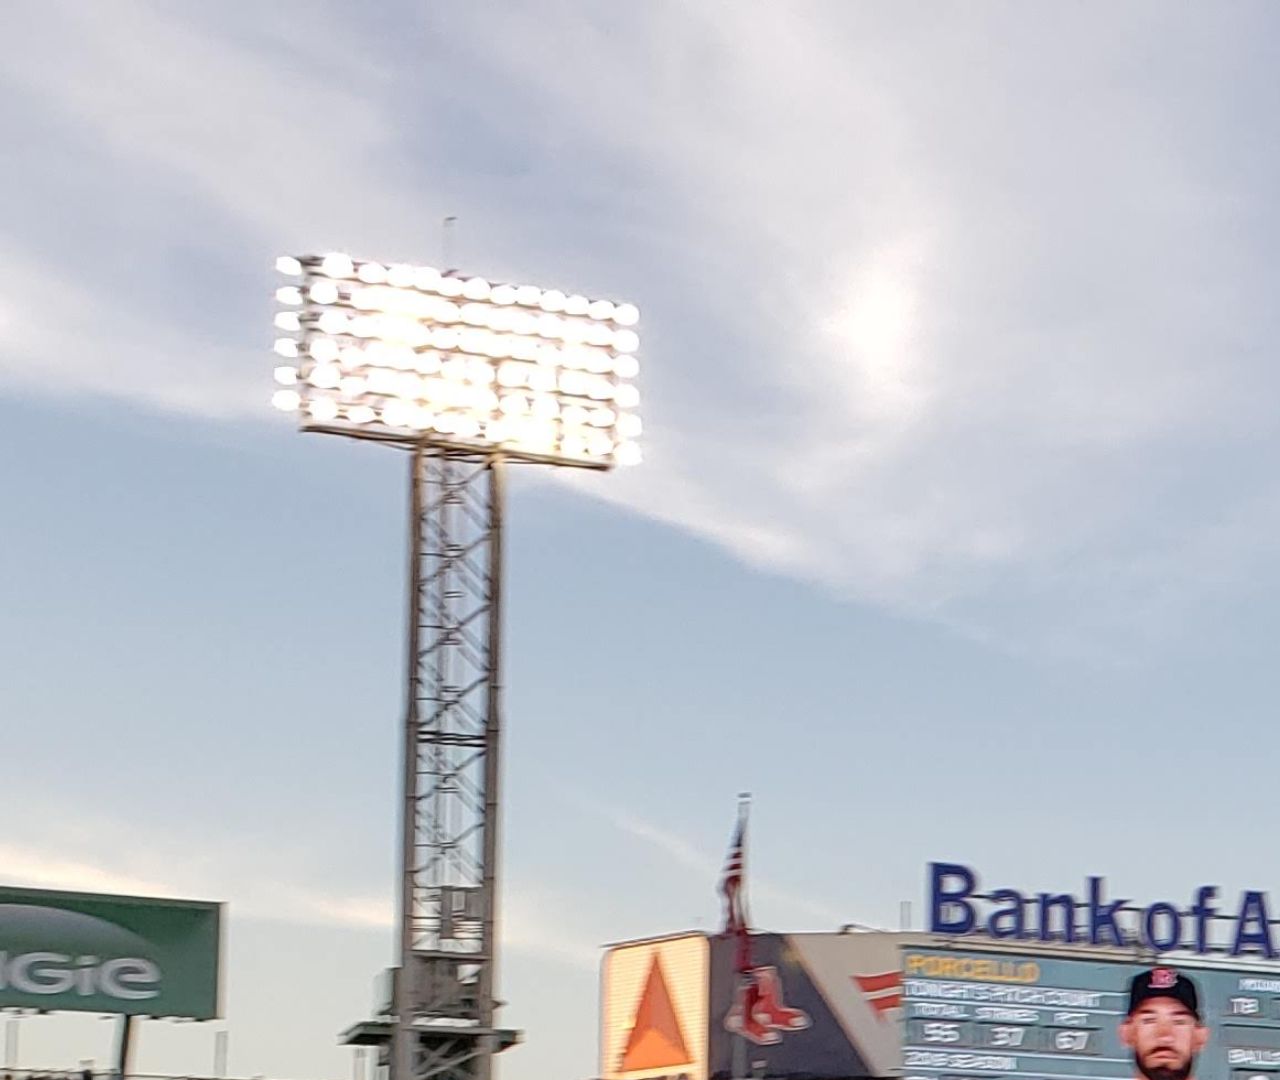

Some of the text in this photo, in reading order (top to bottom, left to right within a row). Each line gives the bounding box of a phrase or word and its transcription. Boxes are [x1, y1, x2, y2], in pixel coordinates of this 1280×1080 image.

[928, 861, 1139, 950] Bank
[1141, 886, 1220, 954] of
[906, 955, 1040, 984] PORCELLO
[1230, 997, 1260, 1014] TB
[990, 1027, 1026, 1046] 37
[1055, 1031, 1089, 1050] 67
